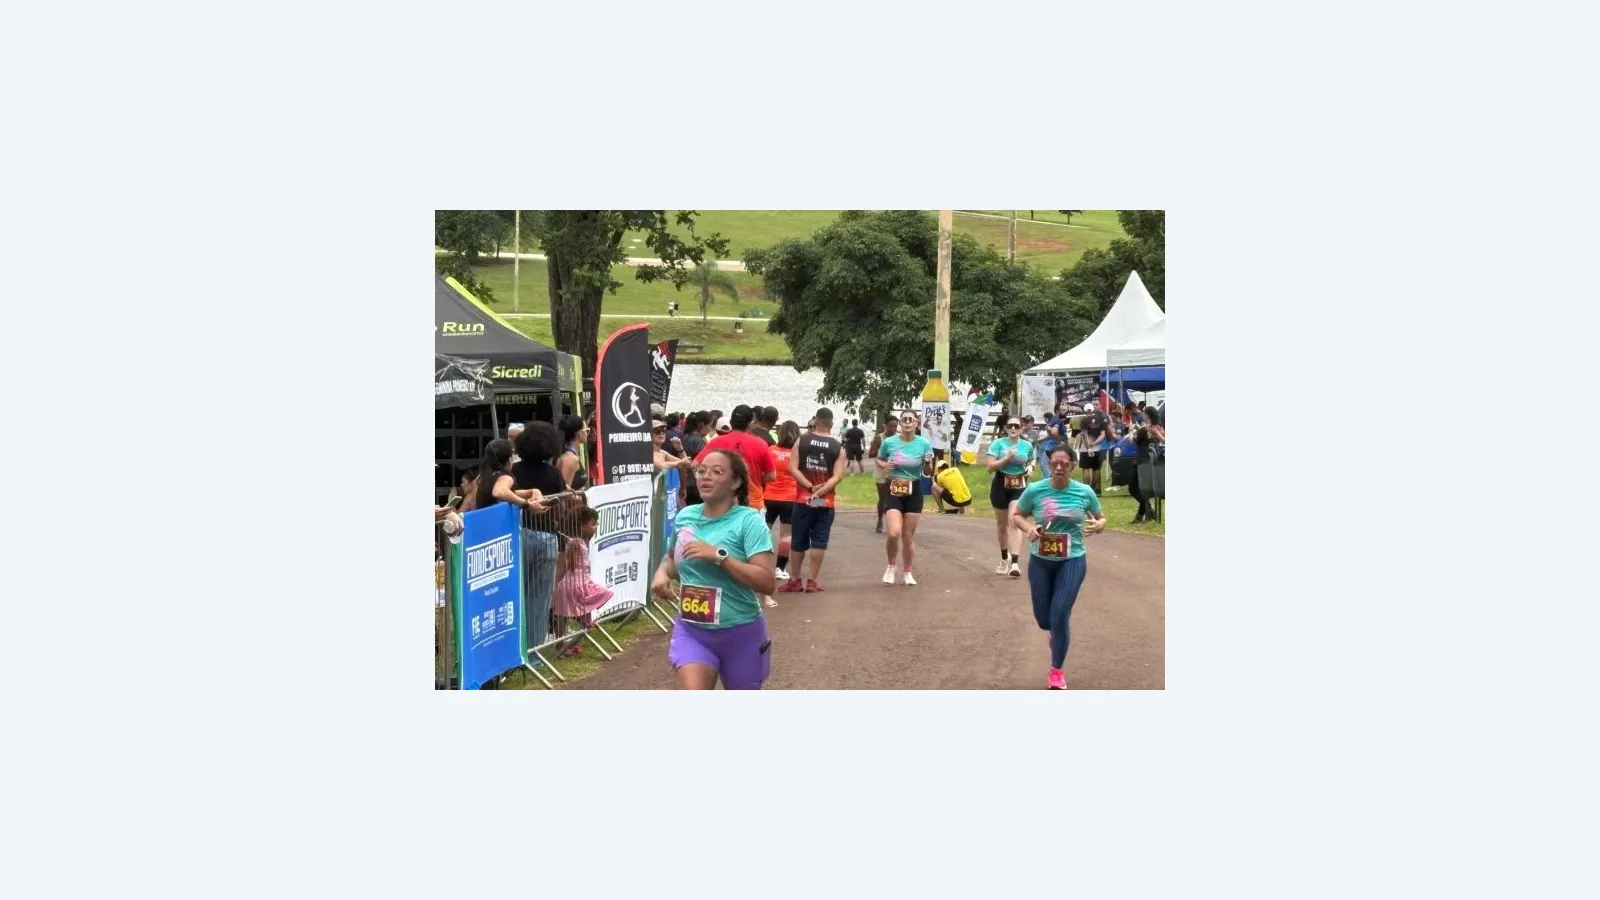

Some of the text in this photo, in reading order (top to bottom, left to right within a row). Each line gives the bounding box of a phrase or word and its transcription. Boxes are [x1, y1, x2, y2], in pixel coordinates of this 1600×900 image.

[443, 321, 485, 332] Run
[492, 365, 542, 378] Sicredi
[609, 432, 643, 443] PRIMEIRO
[810, 439, 829, 448] ATLETA
[595, 501, 649, 539] FUNDESPORTE
[1043, 542, 1064, 552] 241
[467, 538, 514, 578] FUNDESPORTE
[682, 597, 710, 615] 664
